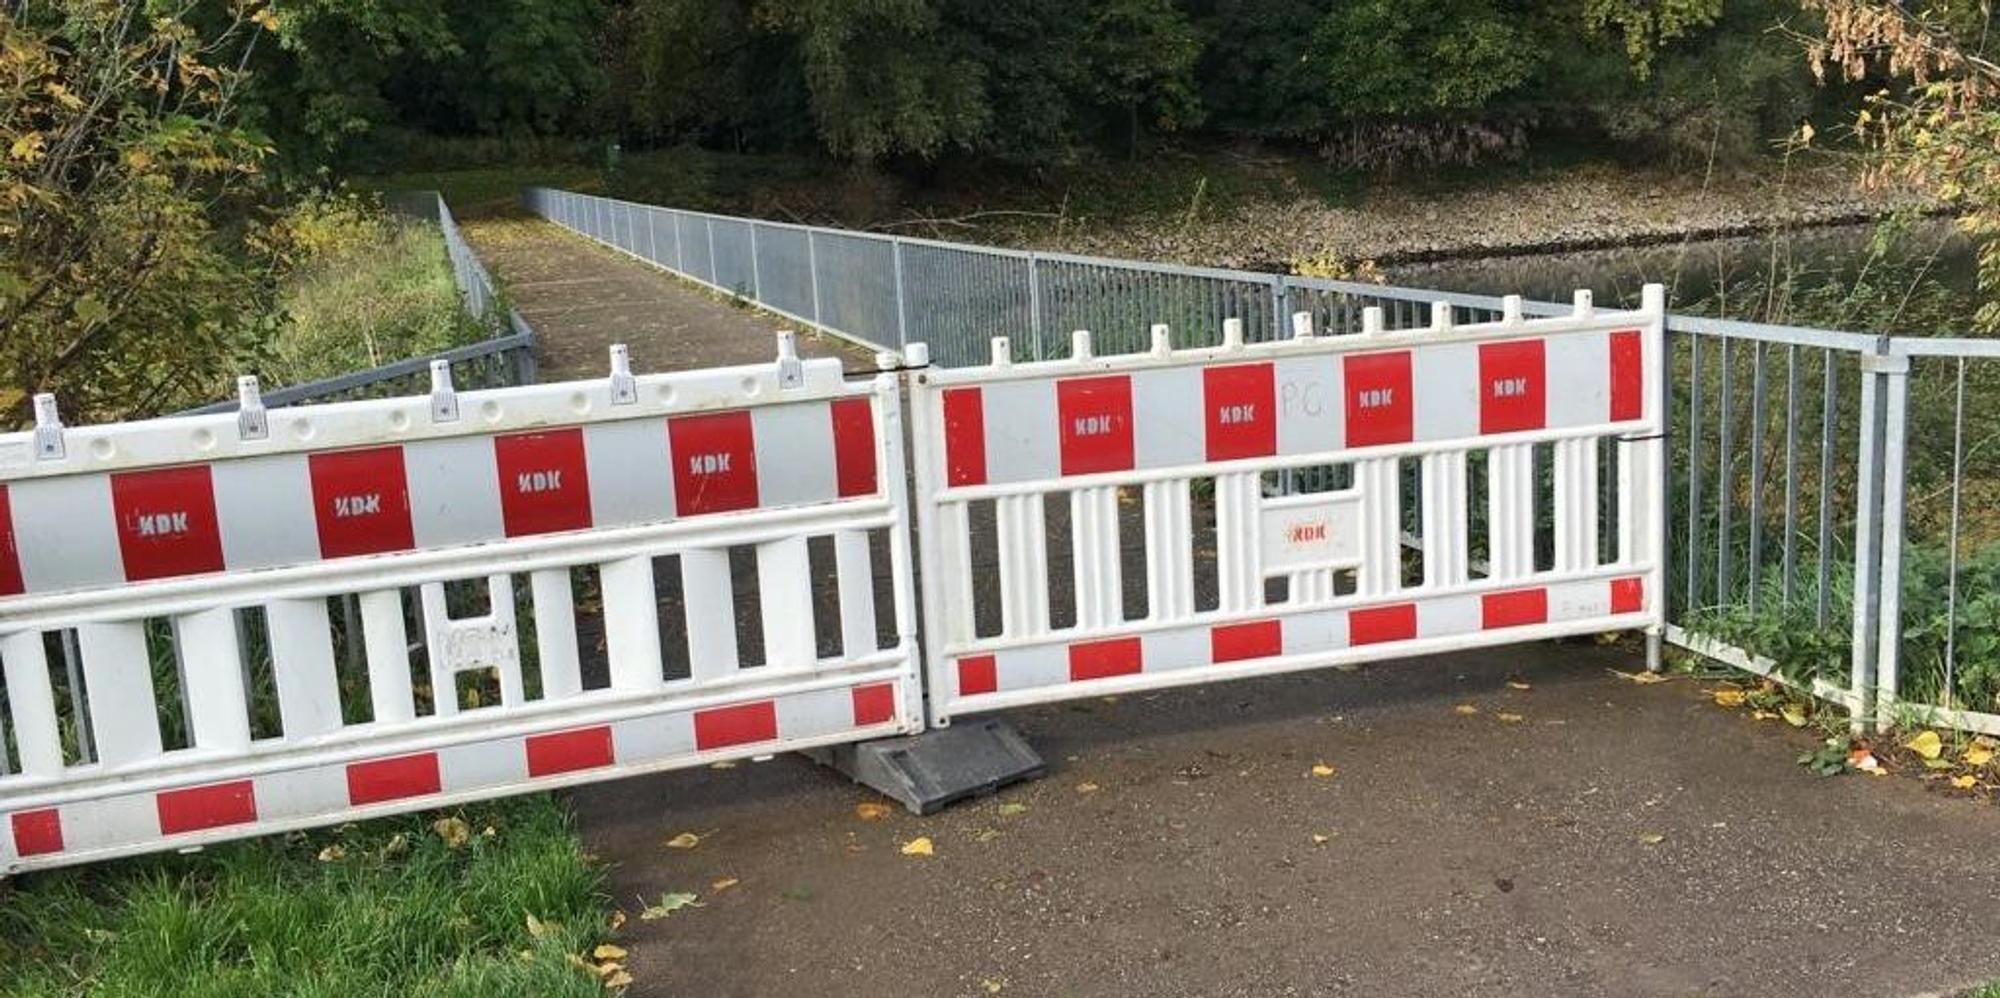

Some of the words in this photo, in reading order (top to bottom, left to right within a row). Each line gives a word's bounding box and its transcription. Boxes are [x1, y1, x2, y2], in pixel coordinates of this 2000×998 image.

[1359, 388, 1393, 408] KDK
[1493, 377, 1527, 397] KDK
[1219, 404, 1254, 424] KDK
[1075, 415, 1112, 437] KDK
[690, 453, 730, 475] KDK
[518, 470, 561, 493] KDK
[334, 493, 381, 518] KDK
[139, 511, 188, 536] KDK
[1291, 523, 1327, 543] KDK
